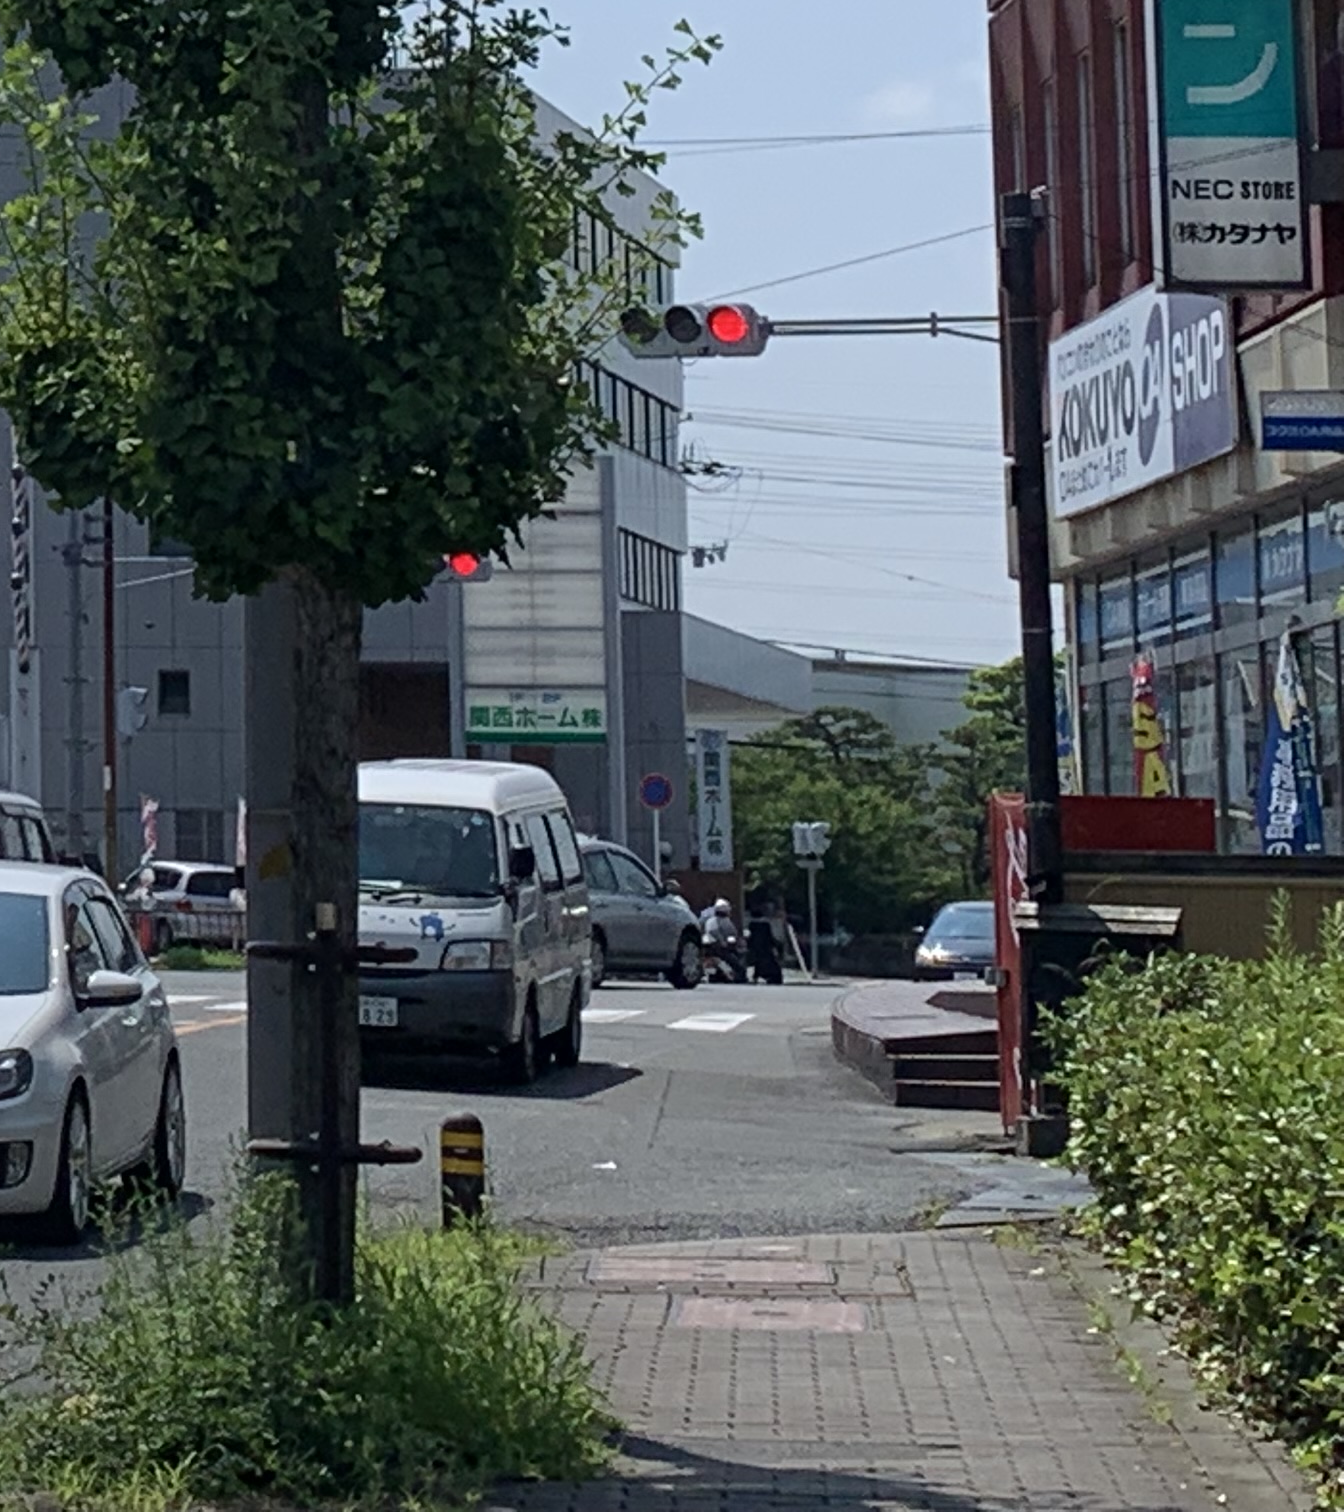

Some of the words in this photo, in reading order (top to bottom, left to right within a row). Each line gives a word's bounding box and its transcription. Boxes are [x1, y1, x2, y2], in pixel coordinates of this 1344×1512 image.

[1171, 179, 1234, 200] NEC
[1240, 181, 1296, 200] STORE
[1058, 358, 1136, 463] KOKUYO
[1172, 308, 1224, 412] SHOP
